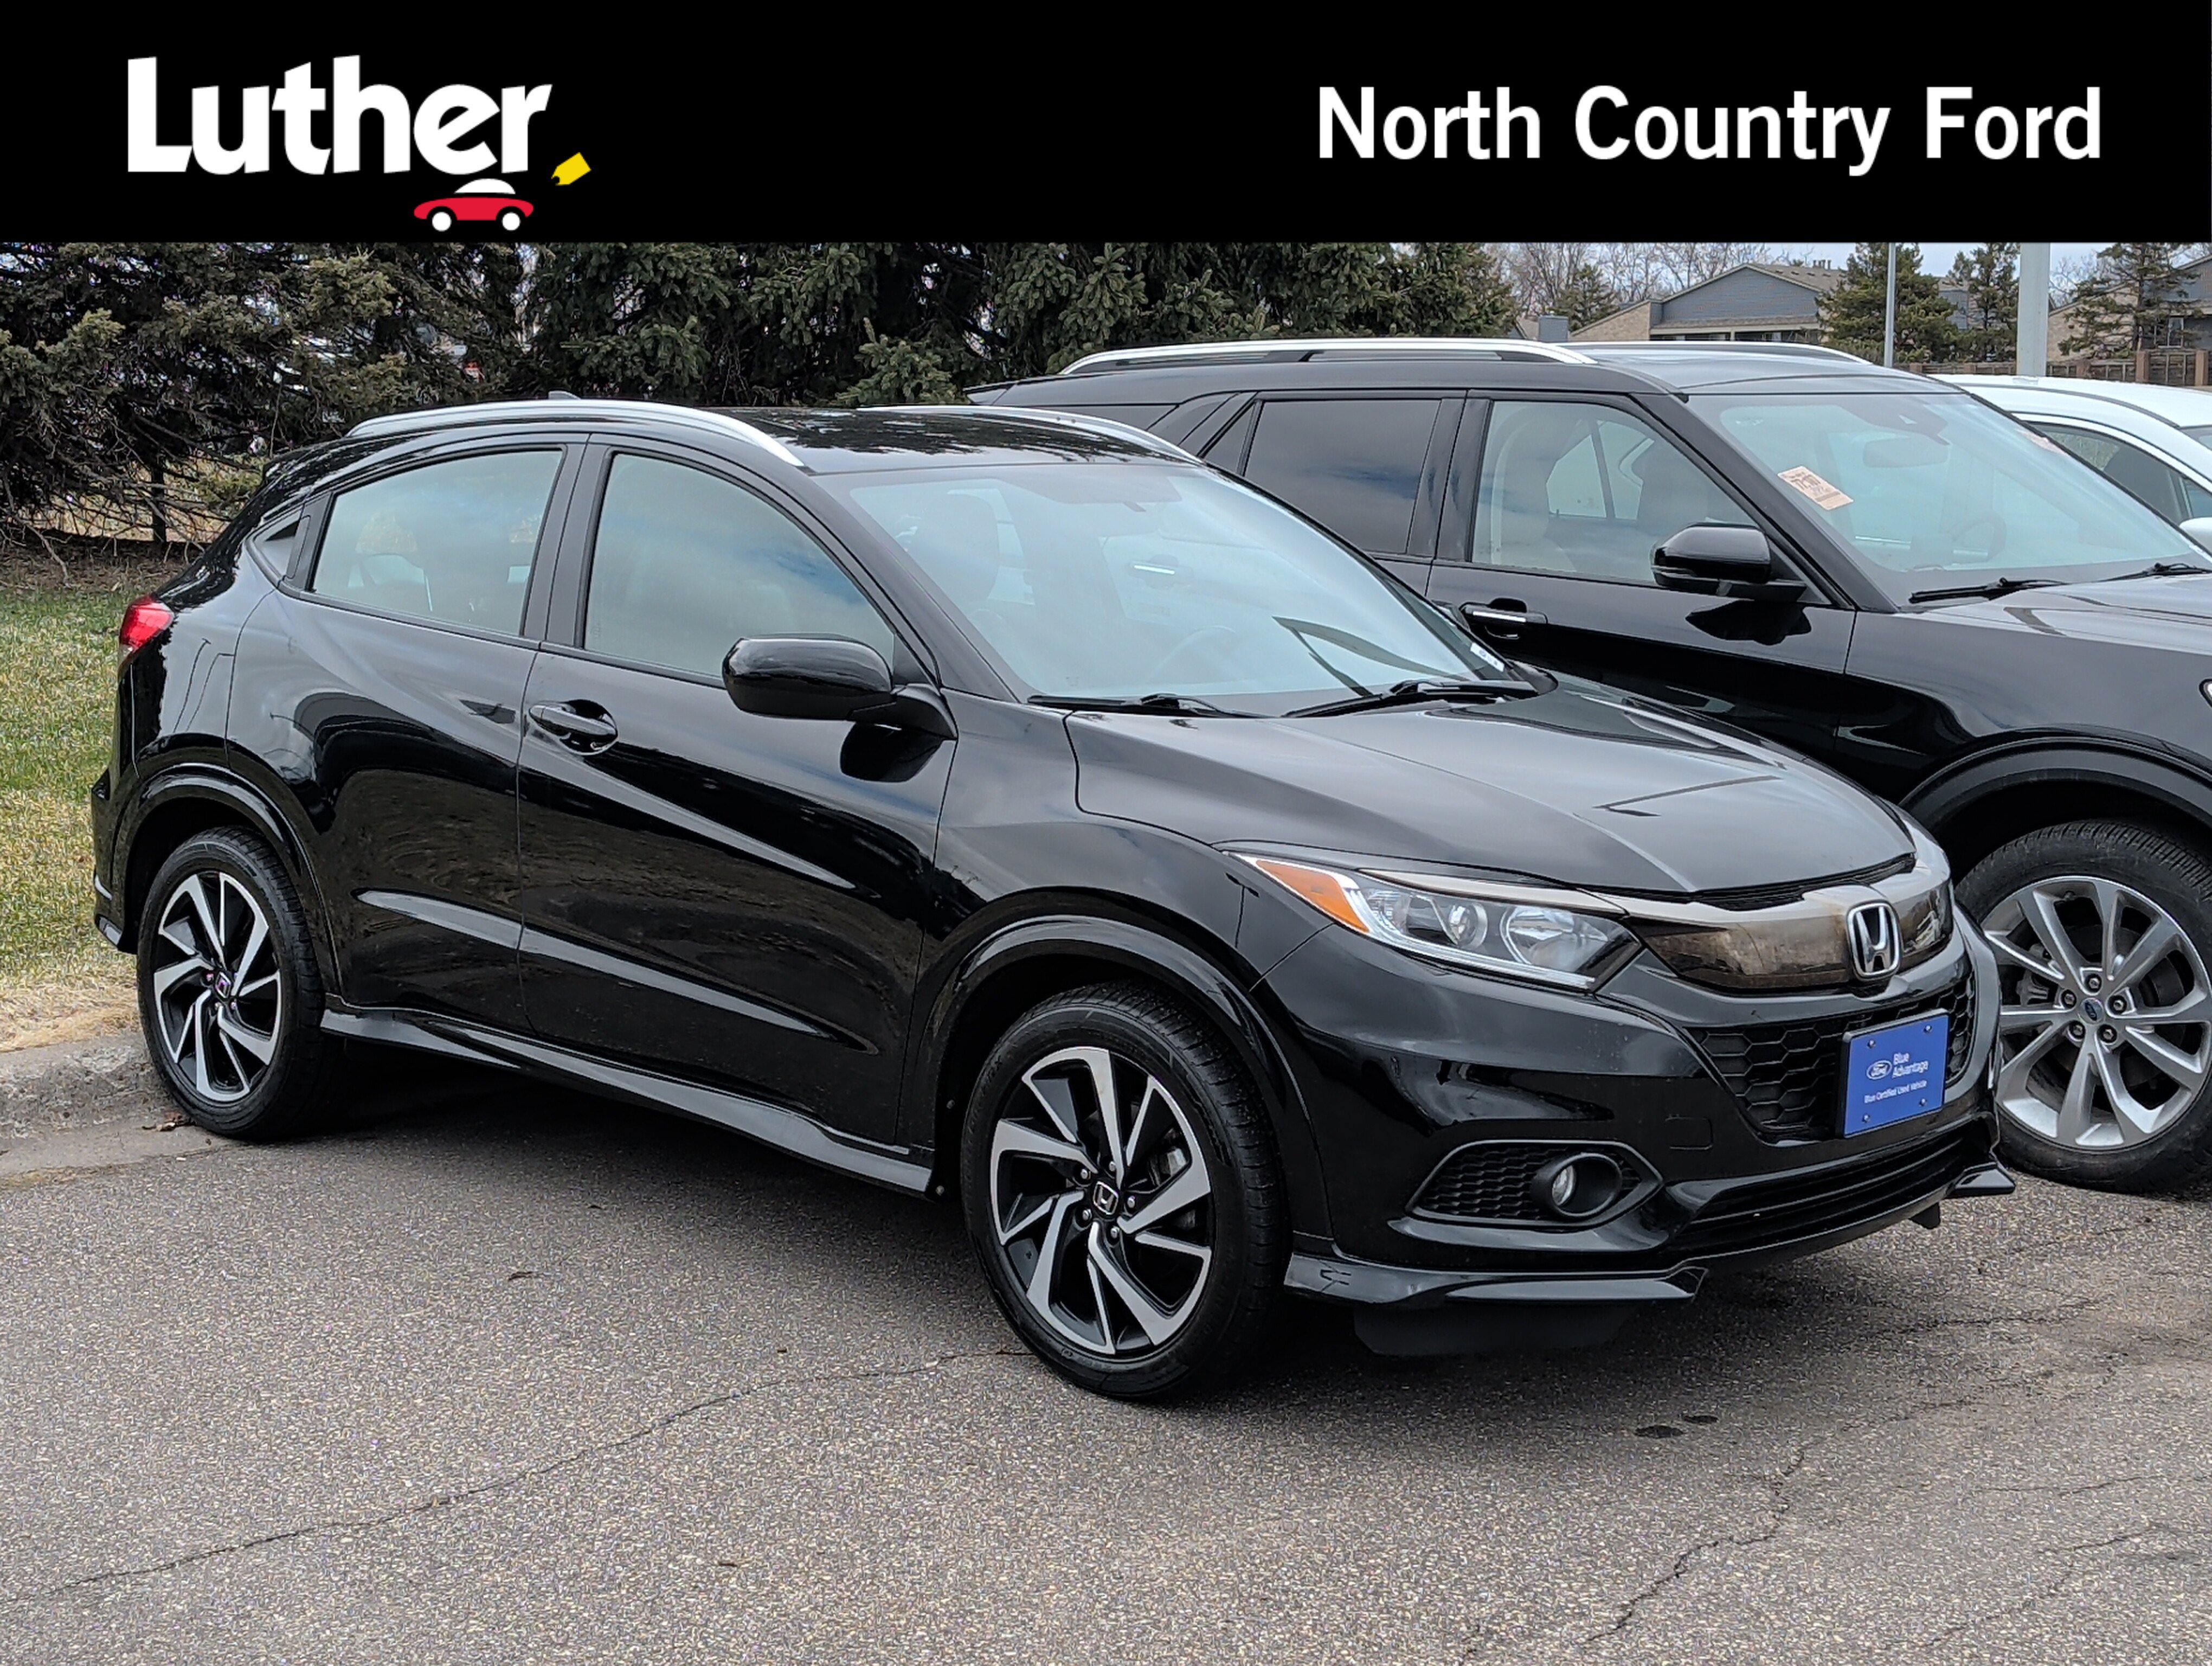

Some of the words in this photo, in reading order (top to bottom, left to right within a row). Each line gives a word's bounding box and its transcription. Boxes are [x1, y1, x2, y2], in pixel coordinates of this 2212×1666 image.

[1893, 1053, 1909, 1065] Blue
[1869, 1062, 1889, 1078] Ford
[1892, 1061, 1928, 1078] Advantage
